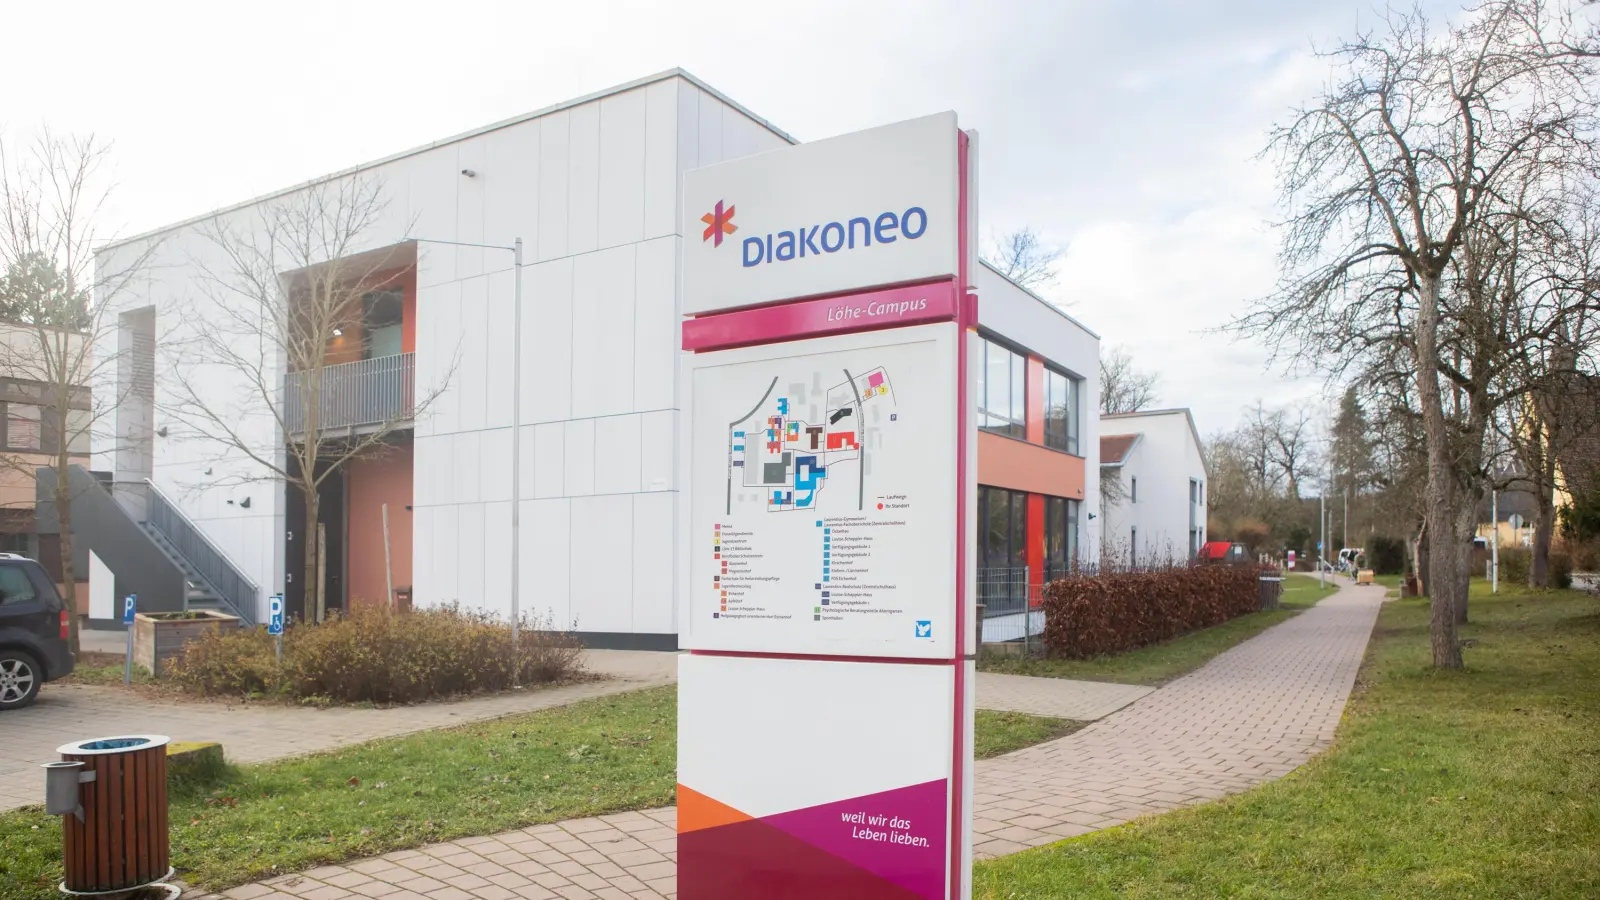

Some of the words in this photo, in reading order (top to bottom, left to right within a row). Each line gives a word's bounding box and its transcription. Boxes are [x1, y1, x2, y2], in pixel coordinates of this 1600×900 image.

[827, 297, 927, 322] Löhe-Campus
[125, 597, 134, 617] P
[270, 597, 282, 626] P
[842, 812, 866, 824] weil
[868, 814, 887, 826] wir
[890, 816, 911, 830] das
[852, 826, 887, 842] Leben
[890, 831, 930, 847] lieben.
